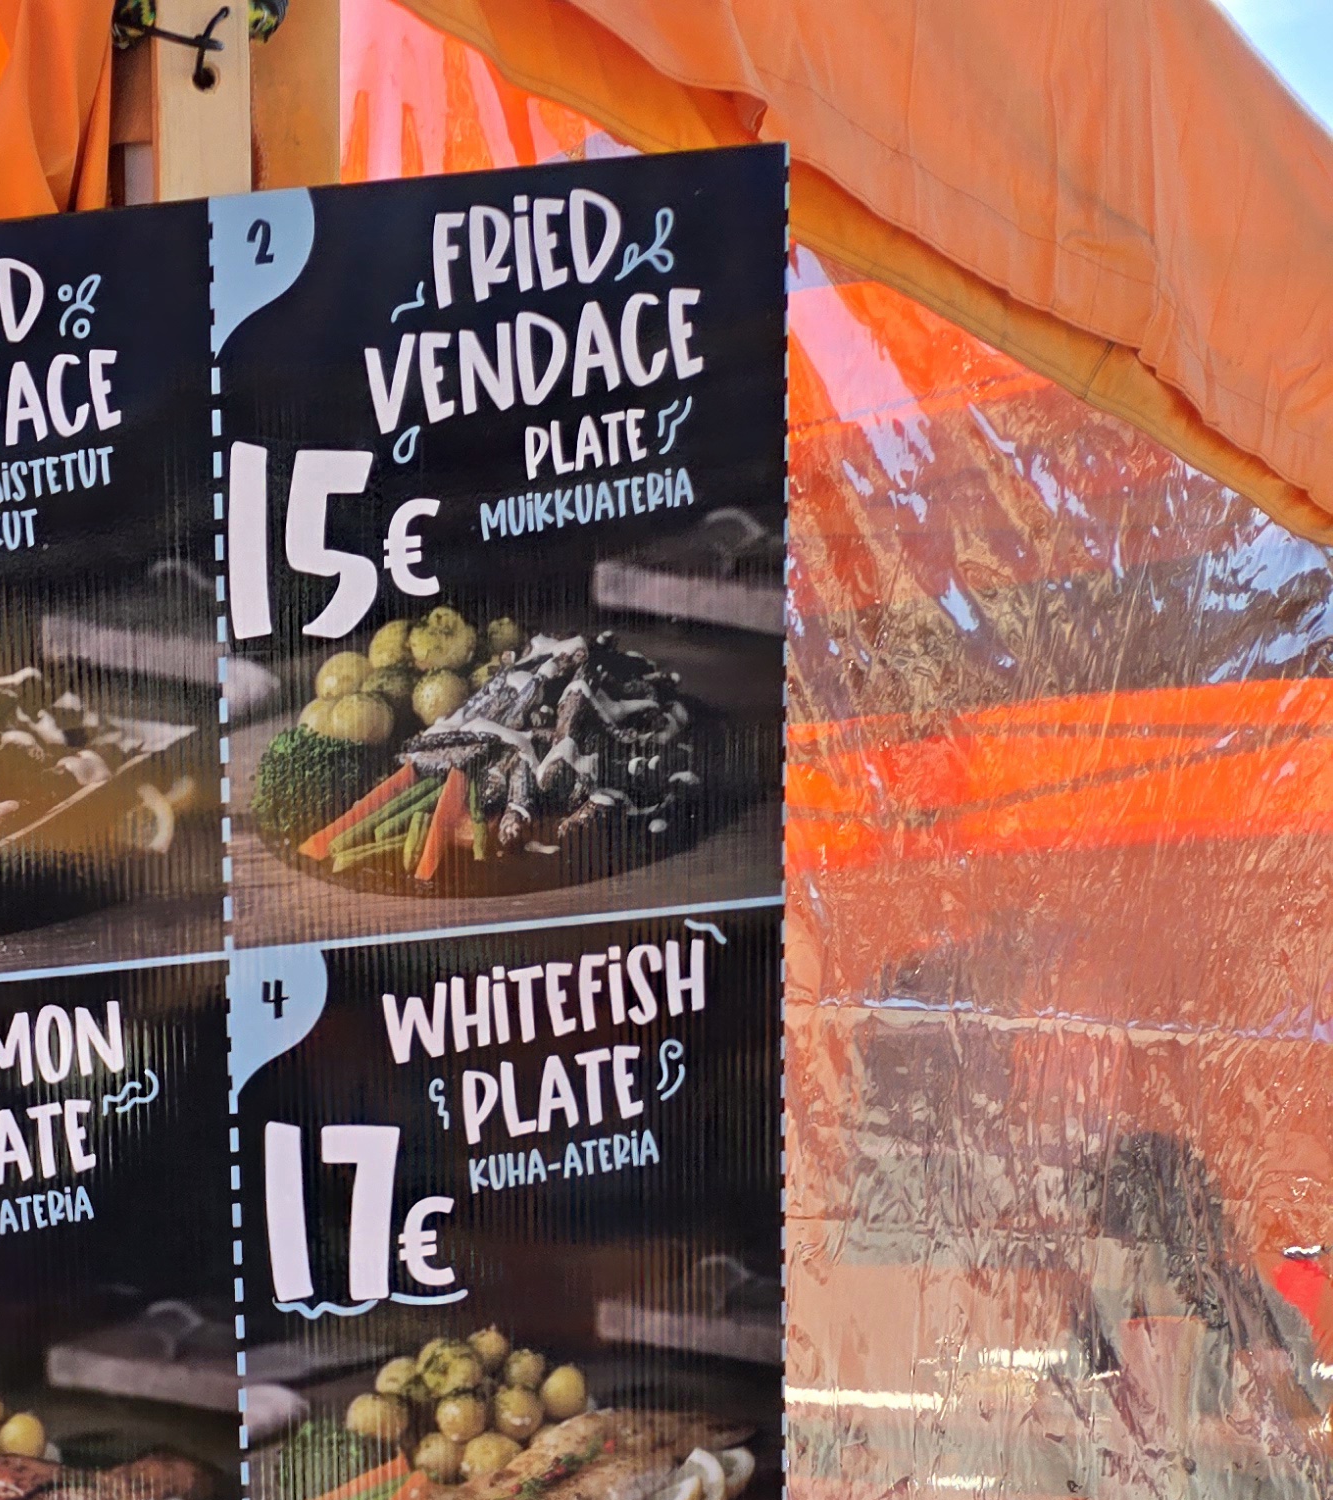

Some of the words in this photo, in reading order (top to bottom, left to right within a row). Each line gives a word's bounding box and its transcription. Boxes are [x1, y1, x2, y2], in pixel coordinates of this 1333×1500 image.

[246, 219, 274, 264] 2
[364, 288, 704, 435] VENDACE
[524, 408, 648, 480] PLATE
[262, 980, 290, 1018] 4
[462, 1044, 644, 1145] PLATE
